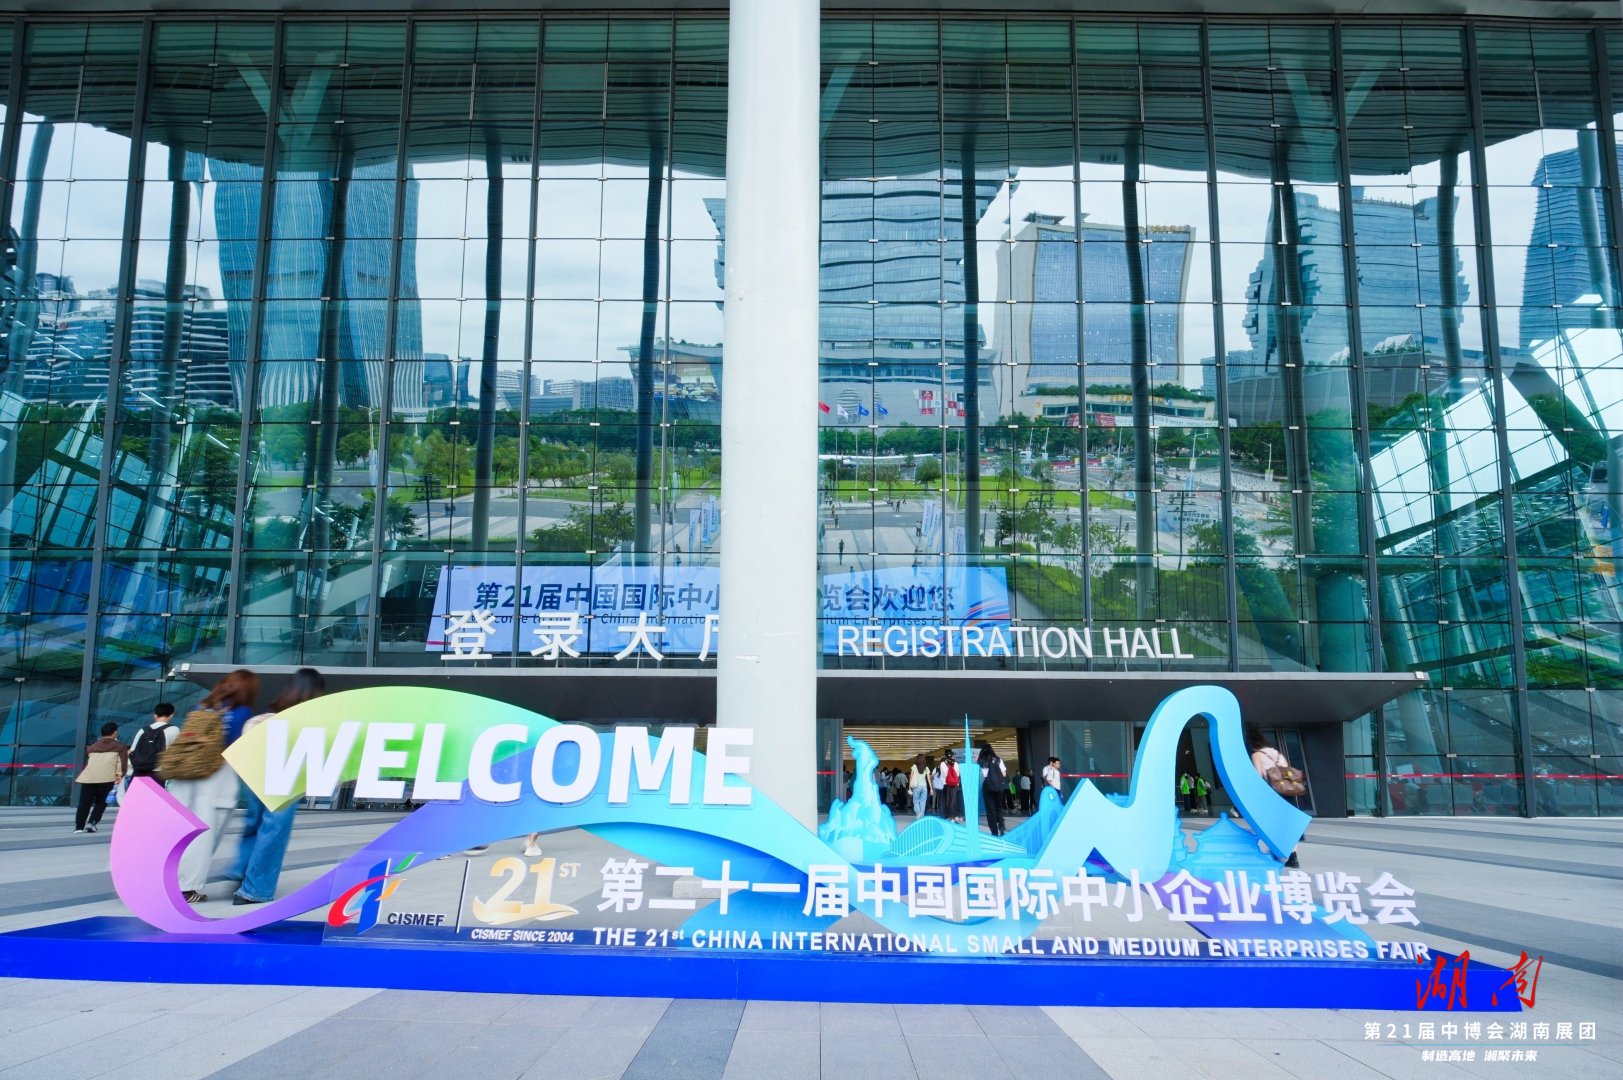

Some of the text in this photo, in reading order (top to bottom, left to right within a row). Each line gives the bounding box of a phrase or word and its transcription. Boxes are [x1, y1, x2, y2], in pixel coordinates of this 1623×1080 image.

[838, 625, 1194, 659] REGISTRATION HALL
[264, 719, 754, 806] WELCOME
[597, 857, 1422, 926] 第二十一届中国国际中小企业博览会
[387, 912, 446, 927] CISMEF
[471, 928, 574, 943] CISMEF SINCE 2004
[593, 927, 637, 946] THE
[692, 929, 763, 949] CHINA
[772, 931, 958, 953] INTERNATIONAL
[967, 934, 1045, 955] SMALL
[1051, 936, 1099, 955] AND
[1108, 937, 1200, 957] MEDIUM
[1207, 938, 1369, 959] ENTERPRISES
[1375, 940, 1431, 961] FAIR
